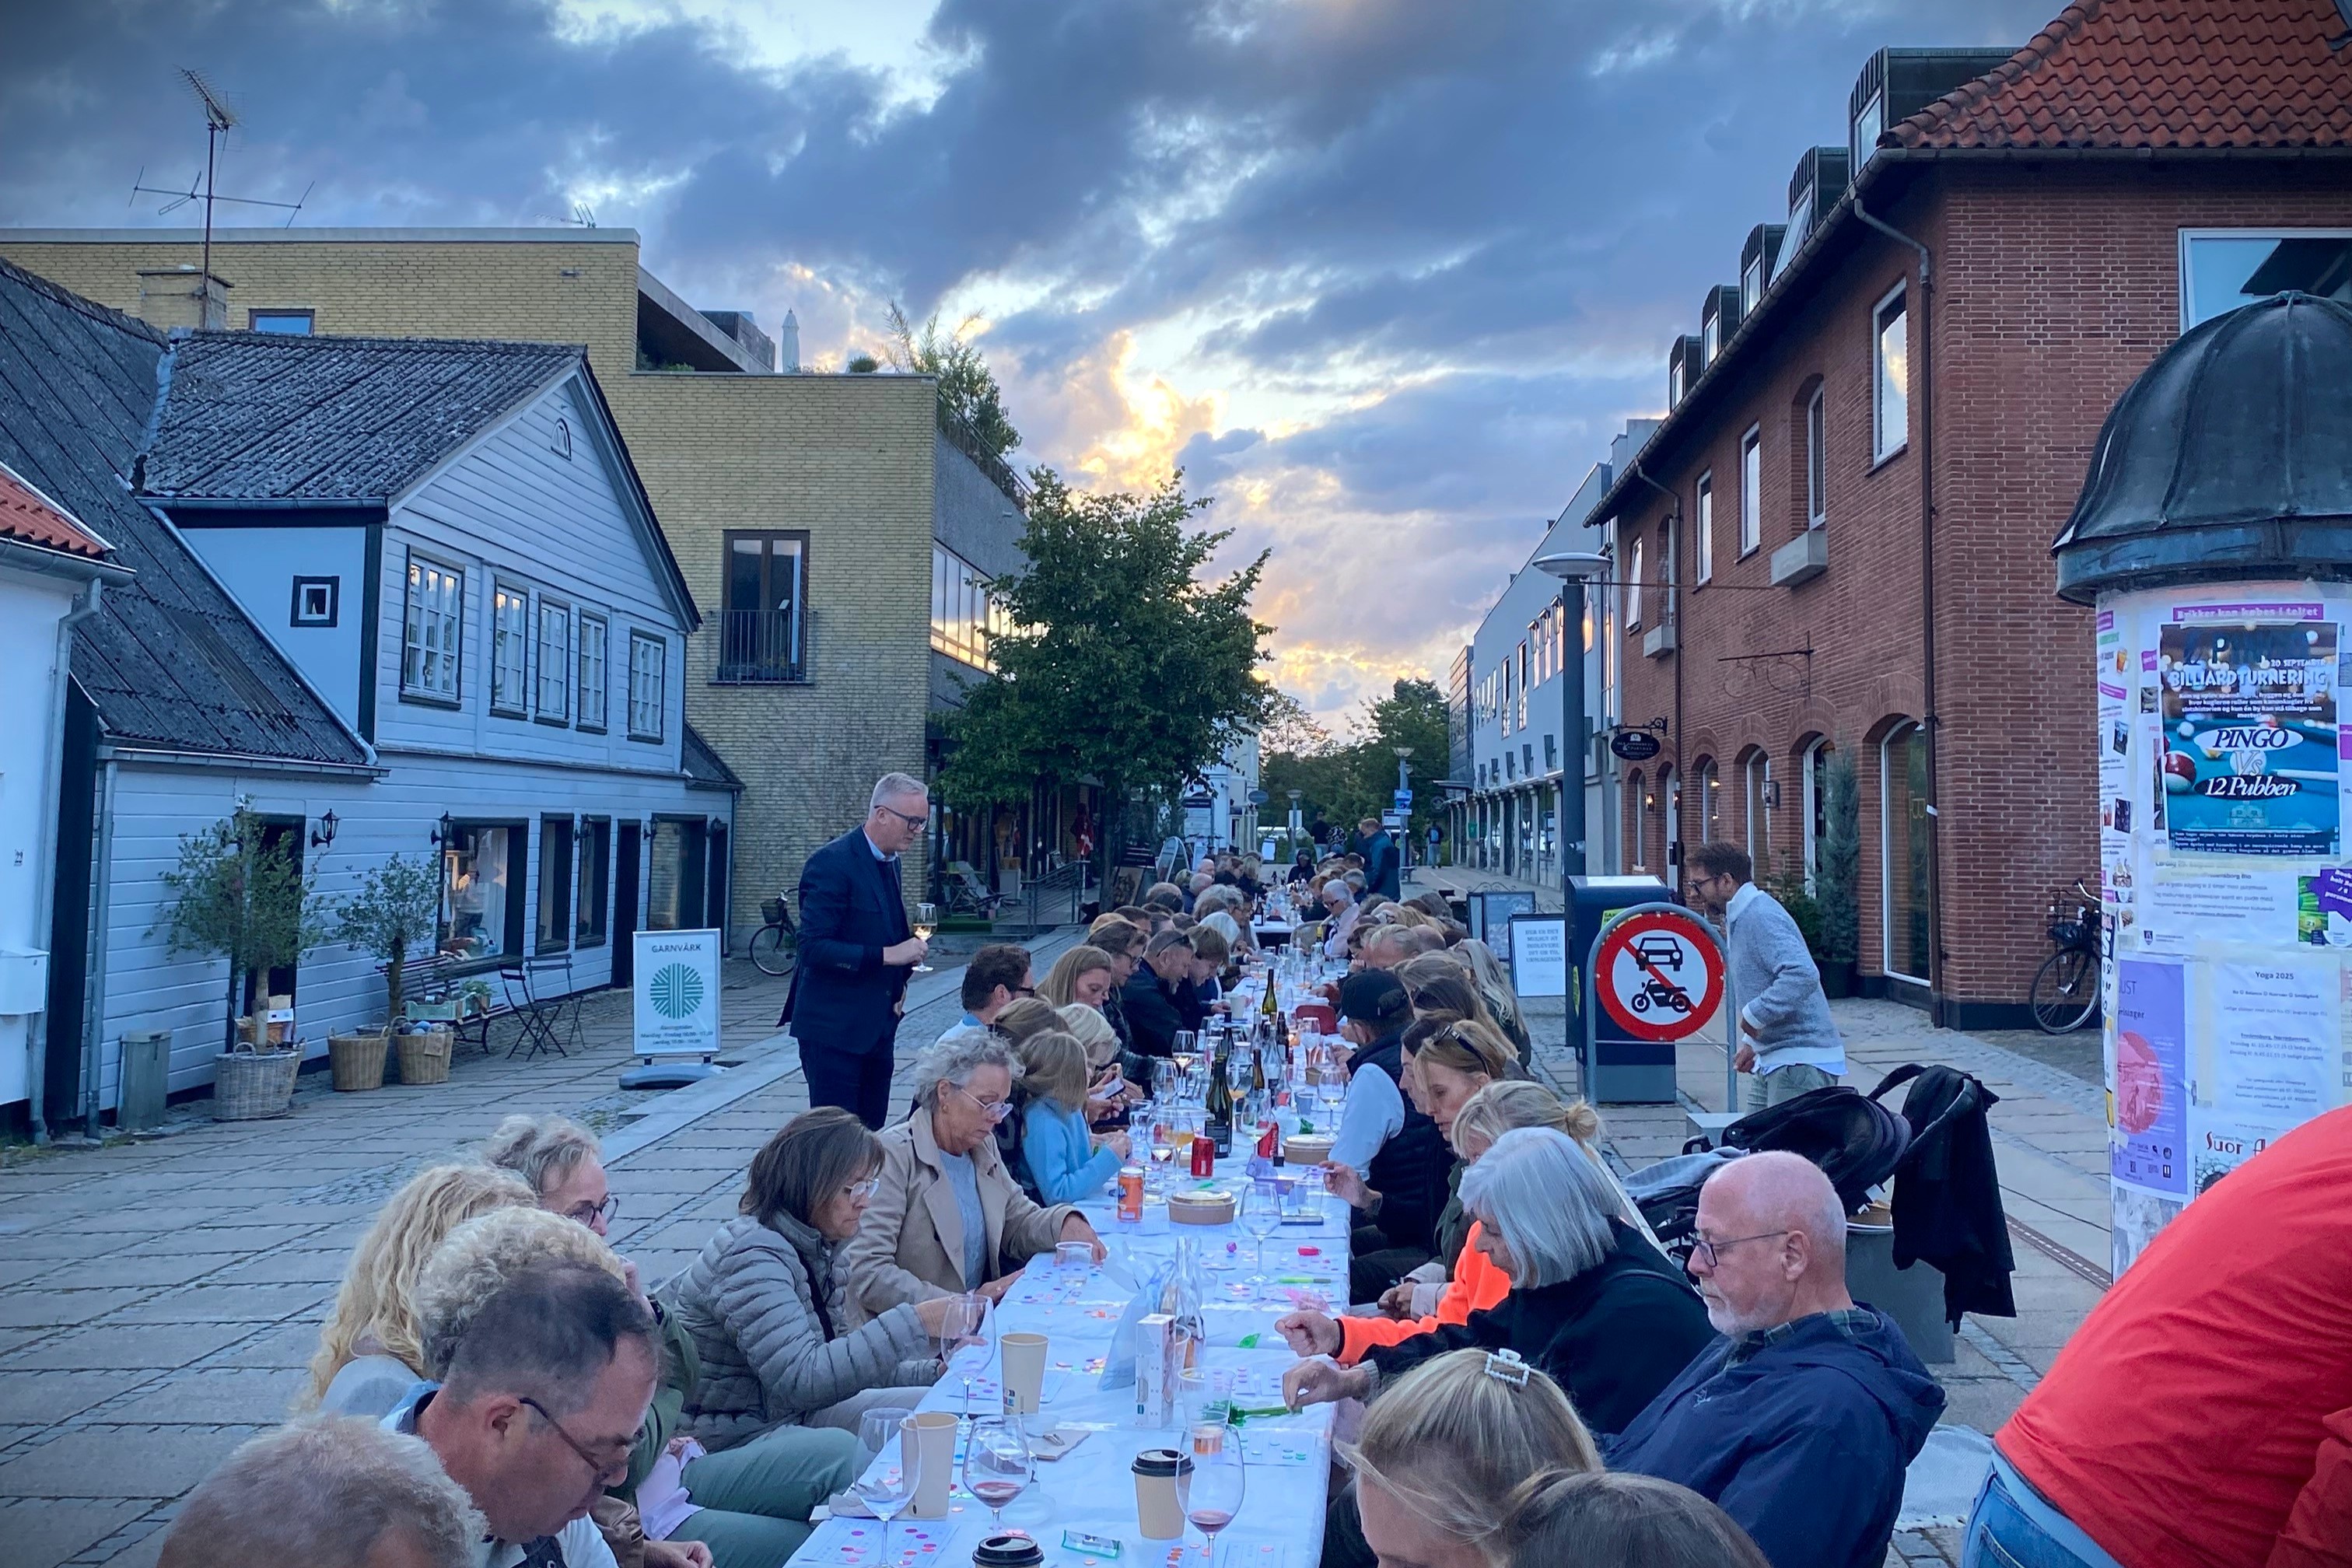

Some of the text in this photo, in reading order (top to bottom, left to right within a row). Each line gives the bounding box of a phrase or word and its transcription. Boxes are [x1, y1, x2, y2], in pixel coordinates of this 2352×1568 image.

[2270, 658, 2326, 667] 20 SEPTEMBER
[2168, 668, 2327, 687] BILLIARDTURNERING
[2213, 729, 2289, 748] PINGO
[2235, 750, 2263, 776] Vs
[2204, 777, 2297, 796] 12 Pubben
[2255, 971, 2273, 980] Yoga
[2207, 1131, 2243, 1154] Suor
